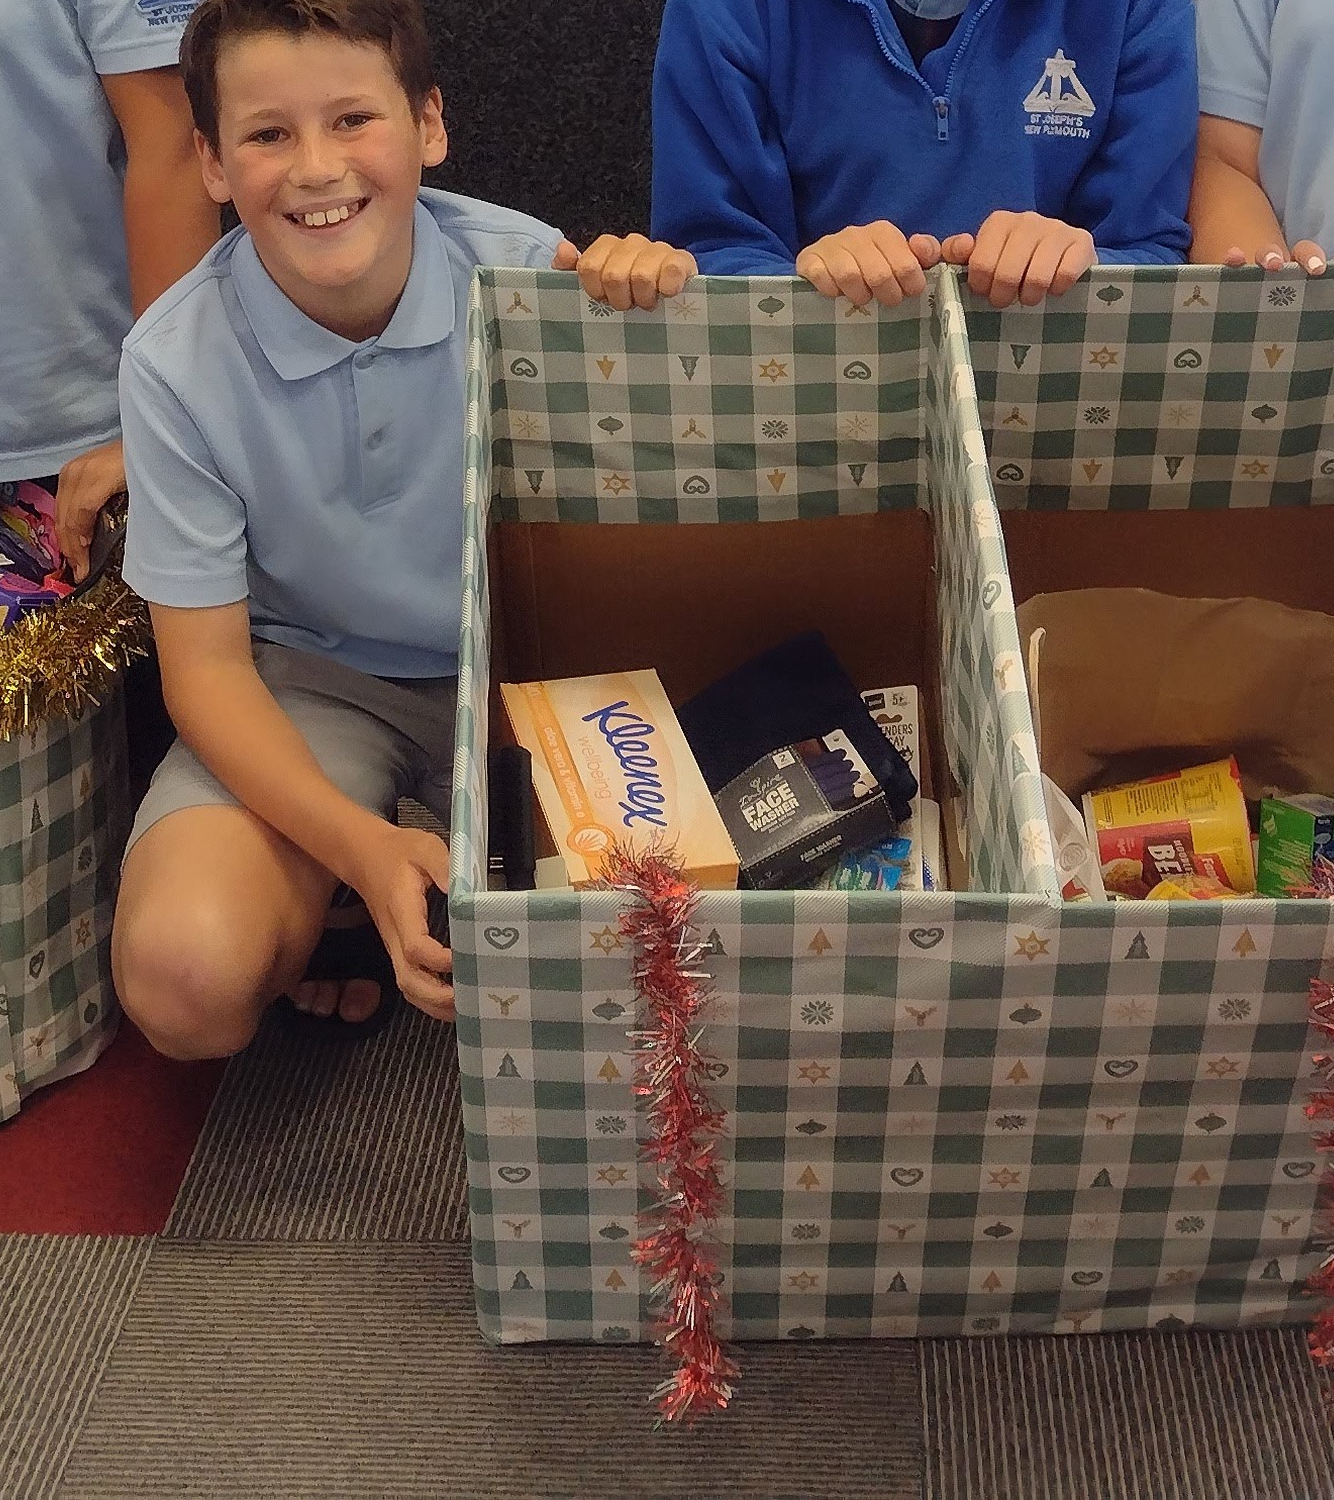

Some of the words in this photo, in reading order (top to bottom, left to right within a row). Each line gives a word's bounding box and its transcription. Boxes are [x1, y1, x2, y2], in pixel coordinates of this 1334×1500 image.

[577, 734, 613, 800] wellbeing
[581, 700, 668, 828] Kleenex
[741, 780, 796, 824] FACE
[748, 796, 801, 833] WASHER
